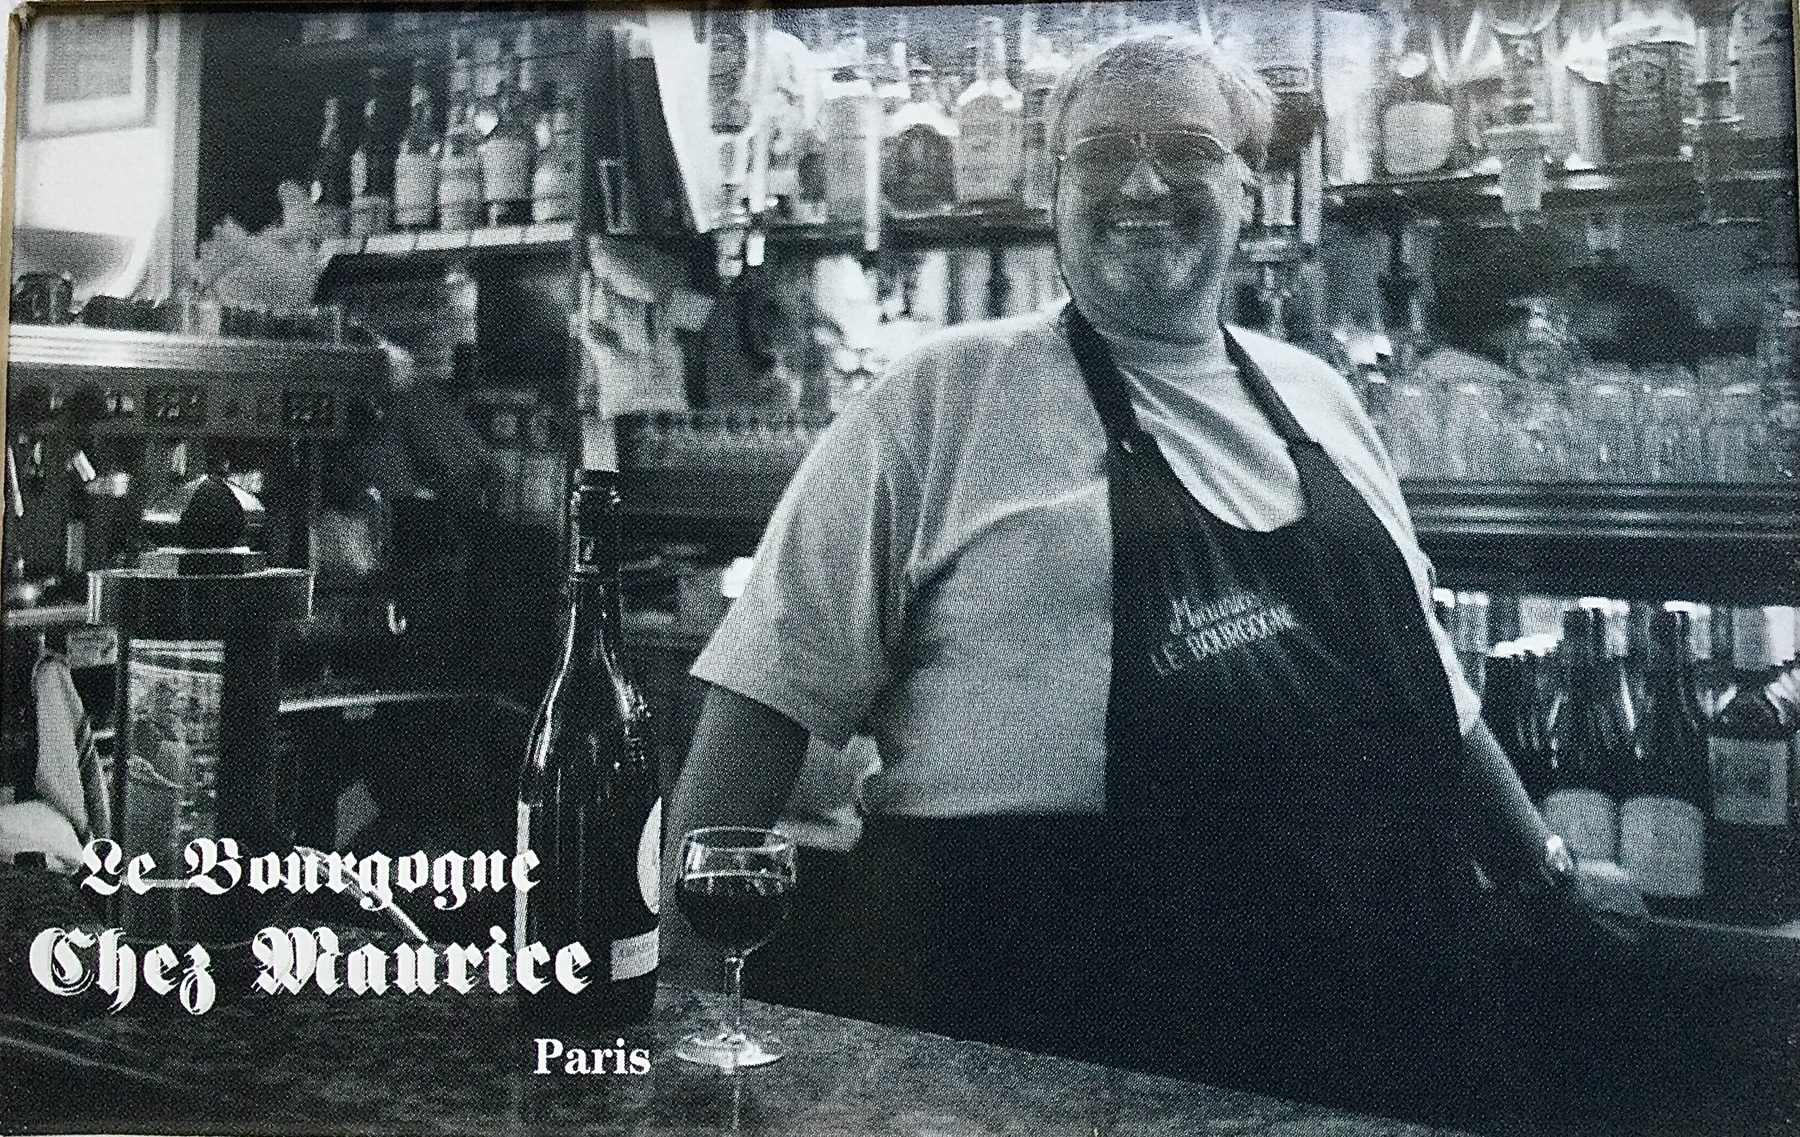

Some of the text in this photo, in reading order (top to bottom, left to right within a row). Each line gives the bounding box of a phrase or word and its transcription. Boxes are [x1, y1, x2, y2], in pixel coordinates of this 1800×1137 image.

[1150, 642, 1184, 676] LE
[81, 838, 541, 911] Le Bourgogne
[29, 926, 593, 1015] Chez Maurice
[533, 1037, 651, 1075] Paris
